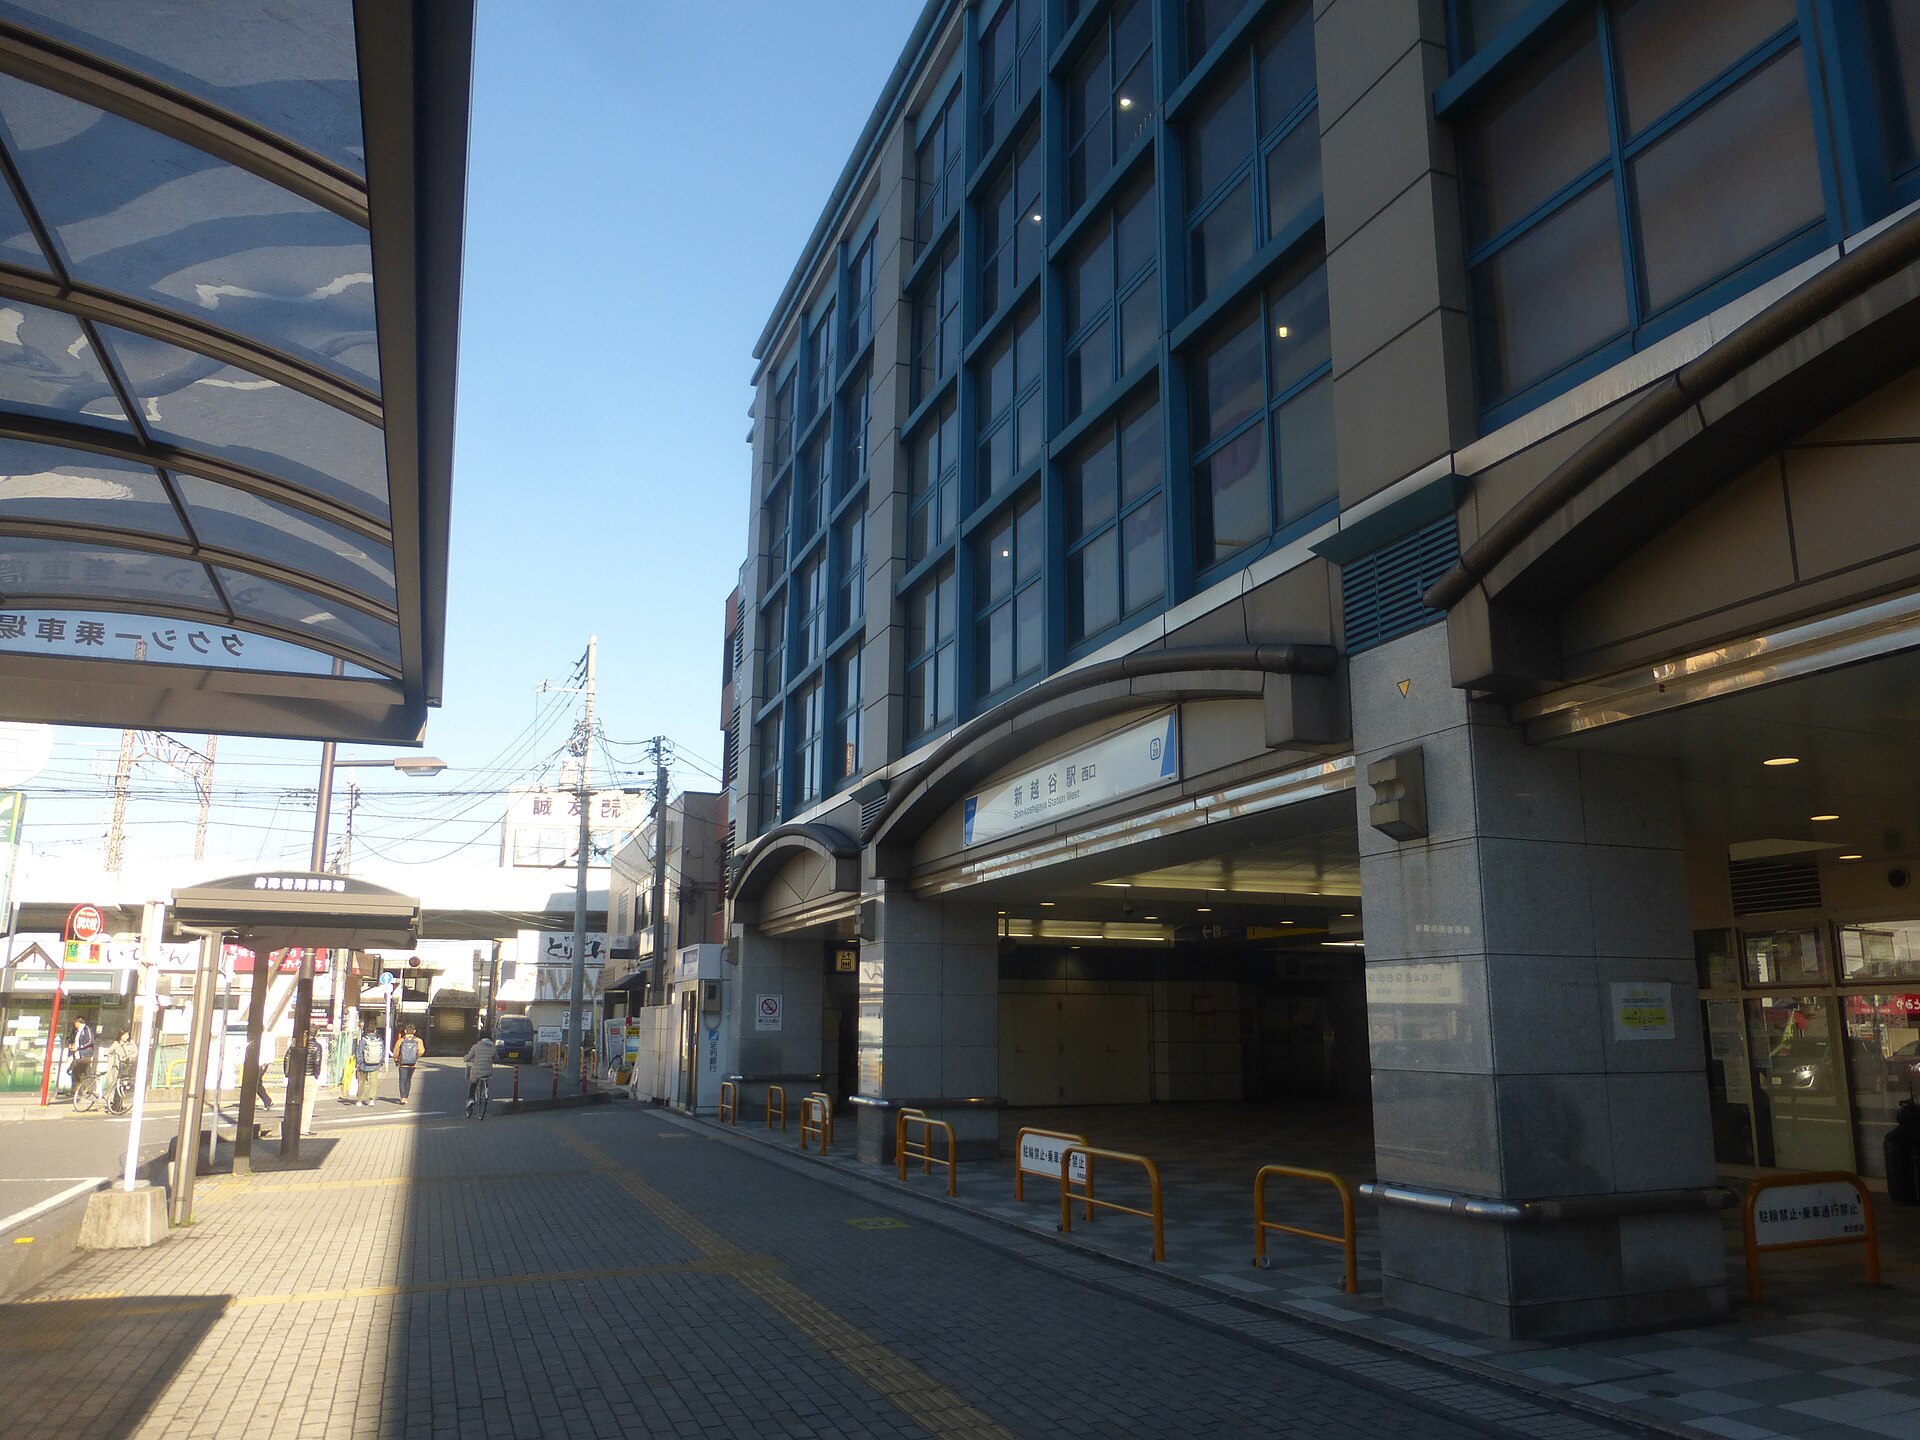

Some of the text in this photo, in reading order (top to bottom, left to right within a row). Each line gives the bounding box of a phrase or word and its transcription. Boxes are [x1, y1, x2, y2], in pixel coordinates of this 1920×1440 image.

[1014, 763, 1096, 807] 新越谷駅 西口
[1048, 794, 1067, 808] Station
[1067, 788, 1080, 802] West
